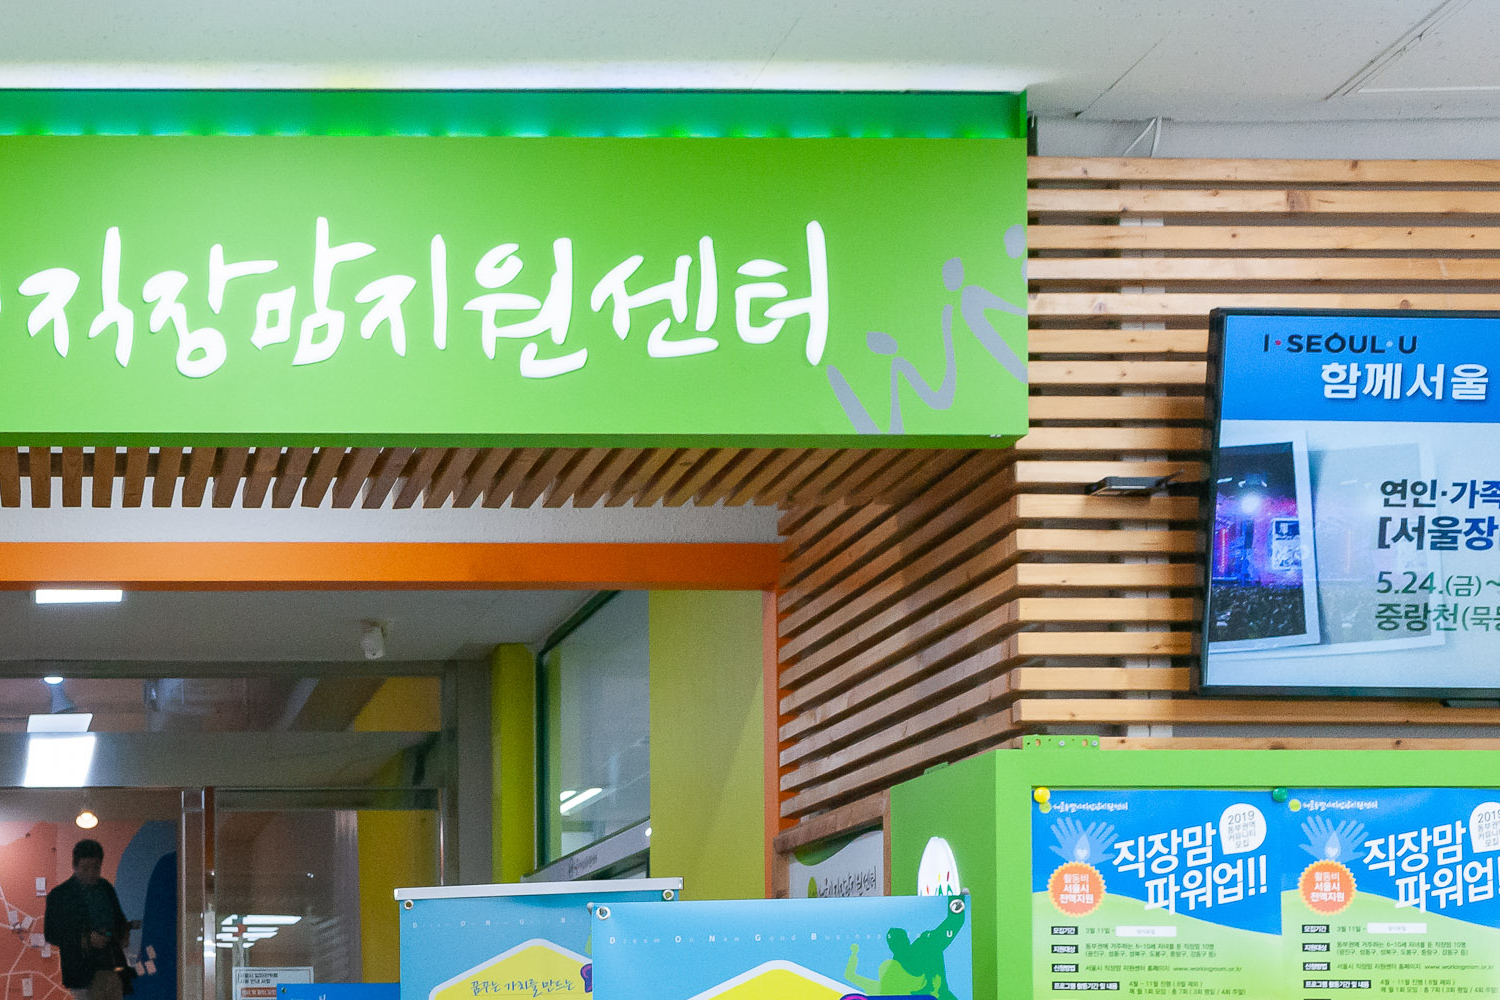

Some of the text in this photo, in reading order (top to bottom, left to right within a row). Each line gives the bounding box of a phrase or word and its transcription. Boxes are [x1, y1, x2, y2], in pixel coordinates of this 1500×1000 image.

[1321, 361, 1489, 401] 함께서울
[1378, 515, 1500, 551] [서울장
[1227, 810, 1255, 825] 2019
[1112, 821, 1217, 879] 직장맘
[1362, 820, 1467, 877] 직장맘
[1144, 854, 1268, 915] 파워업!!
